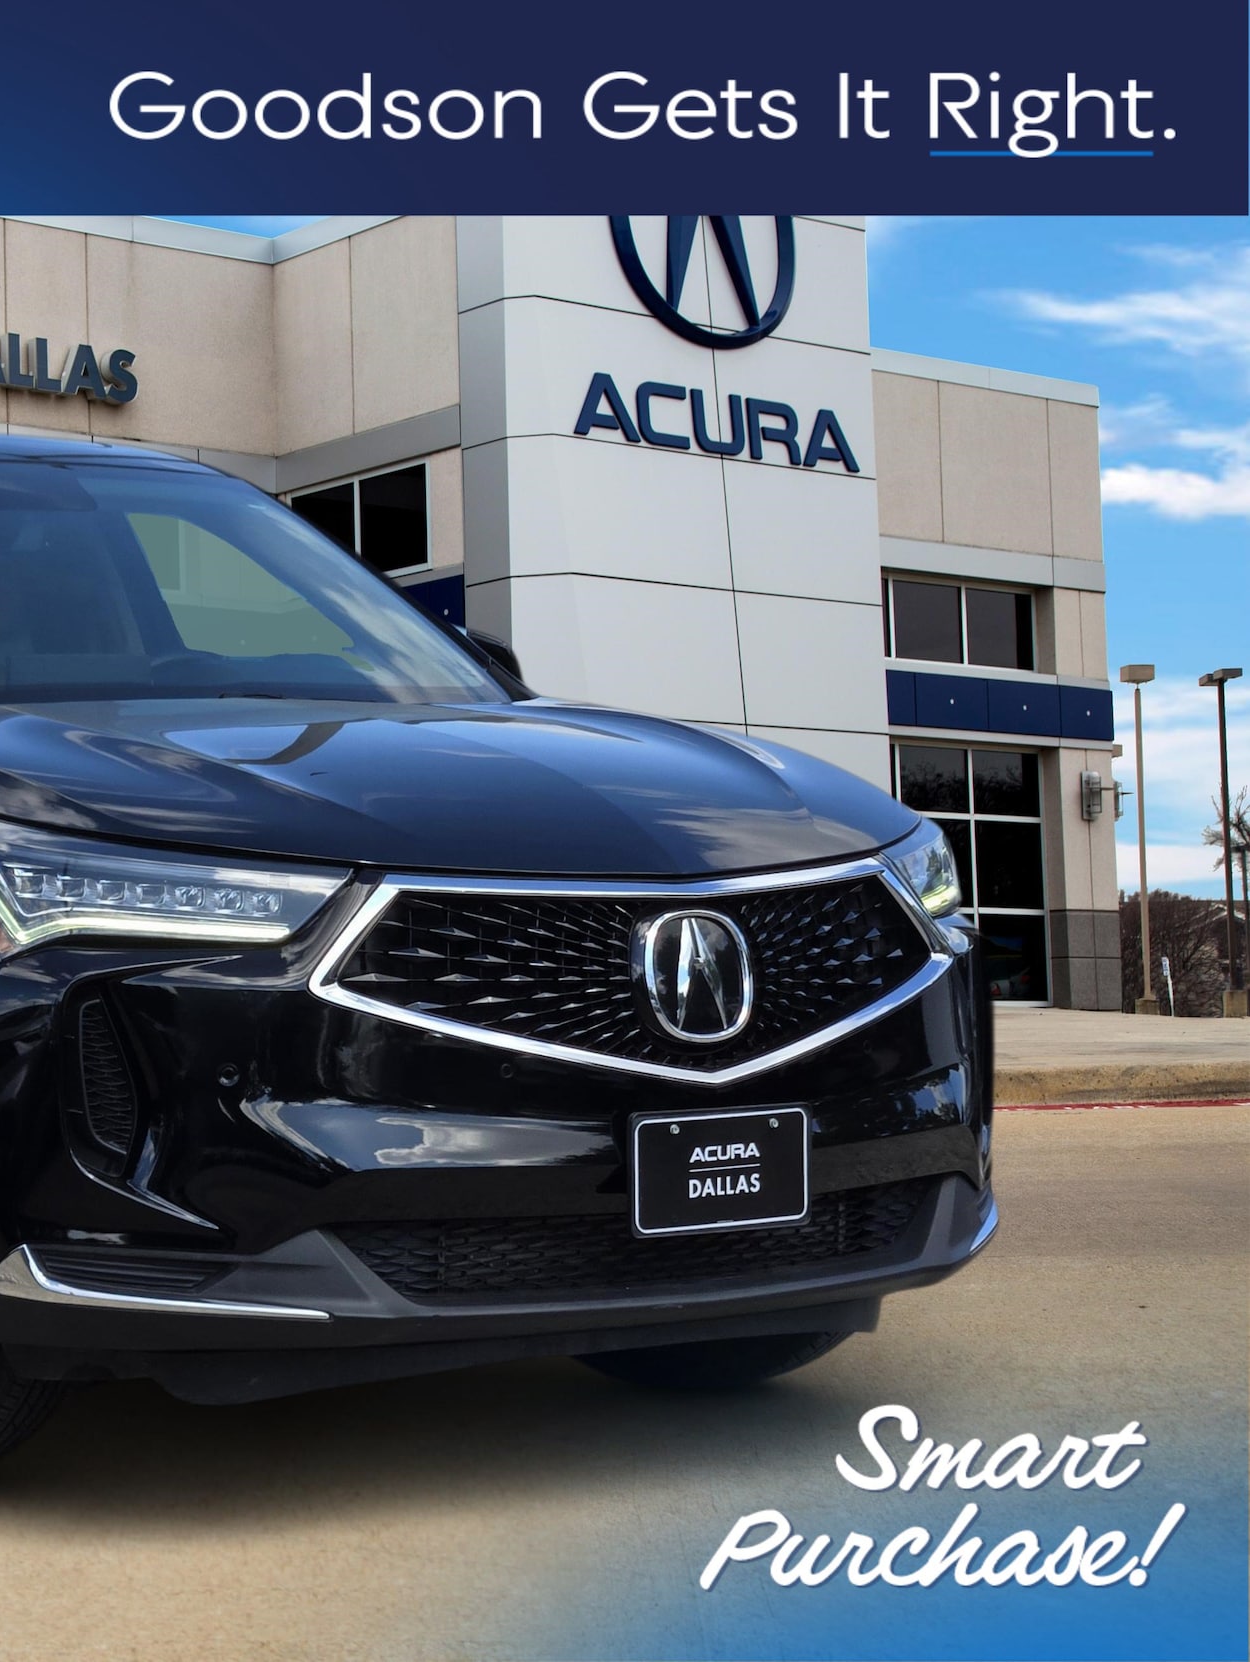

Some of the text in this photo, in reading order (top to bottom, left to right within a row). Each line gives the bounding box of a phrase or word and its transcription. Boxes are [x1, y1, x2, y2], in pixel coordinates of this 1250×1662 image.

[573, 372, 860, 473] ACURA
[689, 1142, 761, 1163] ACURA
[688, 1172, 761, 1199] DALLAS
